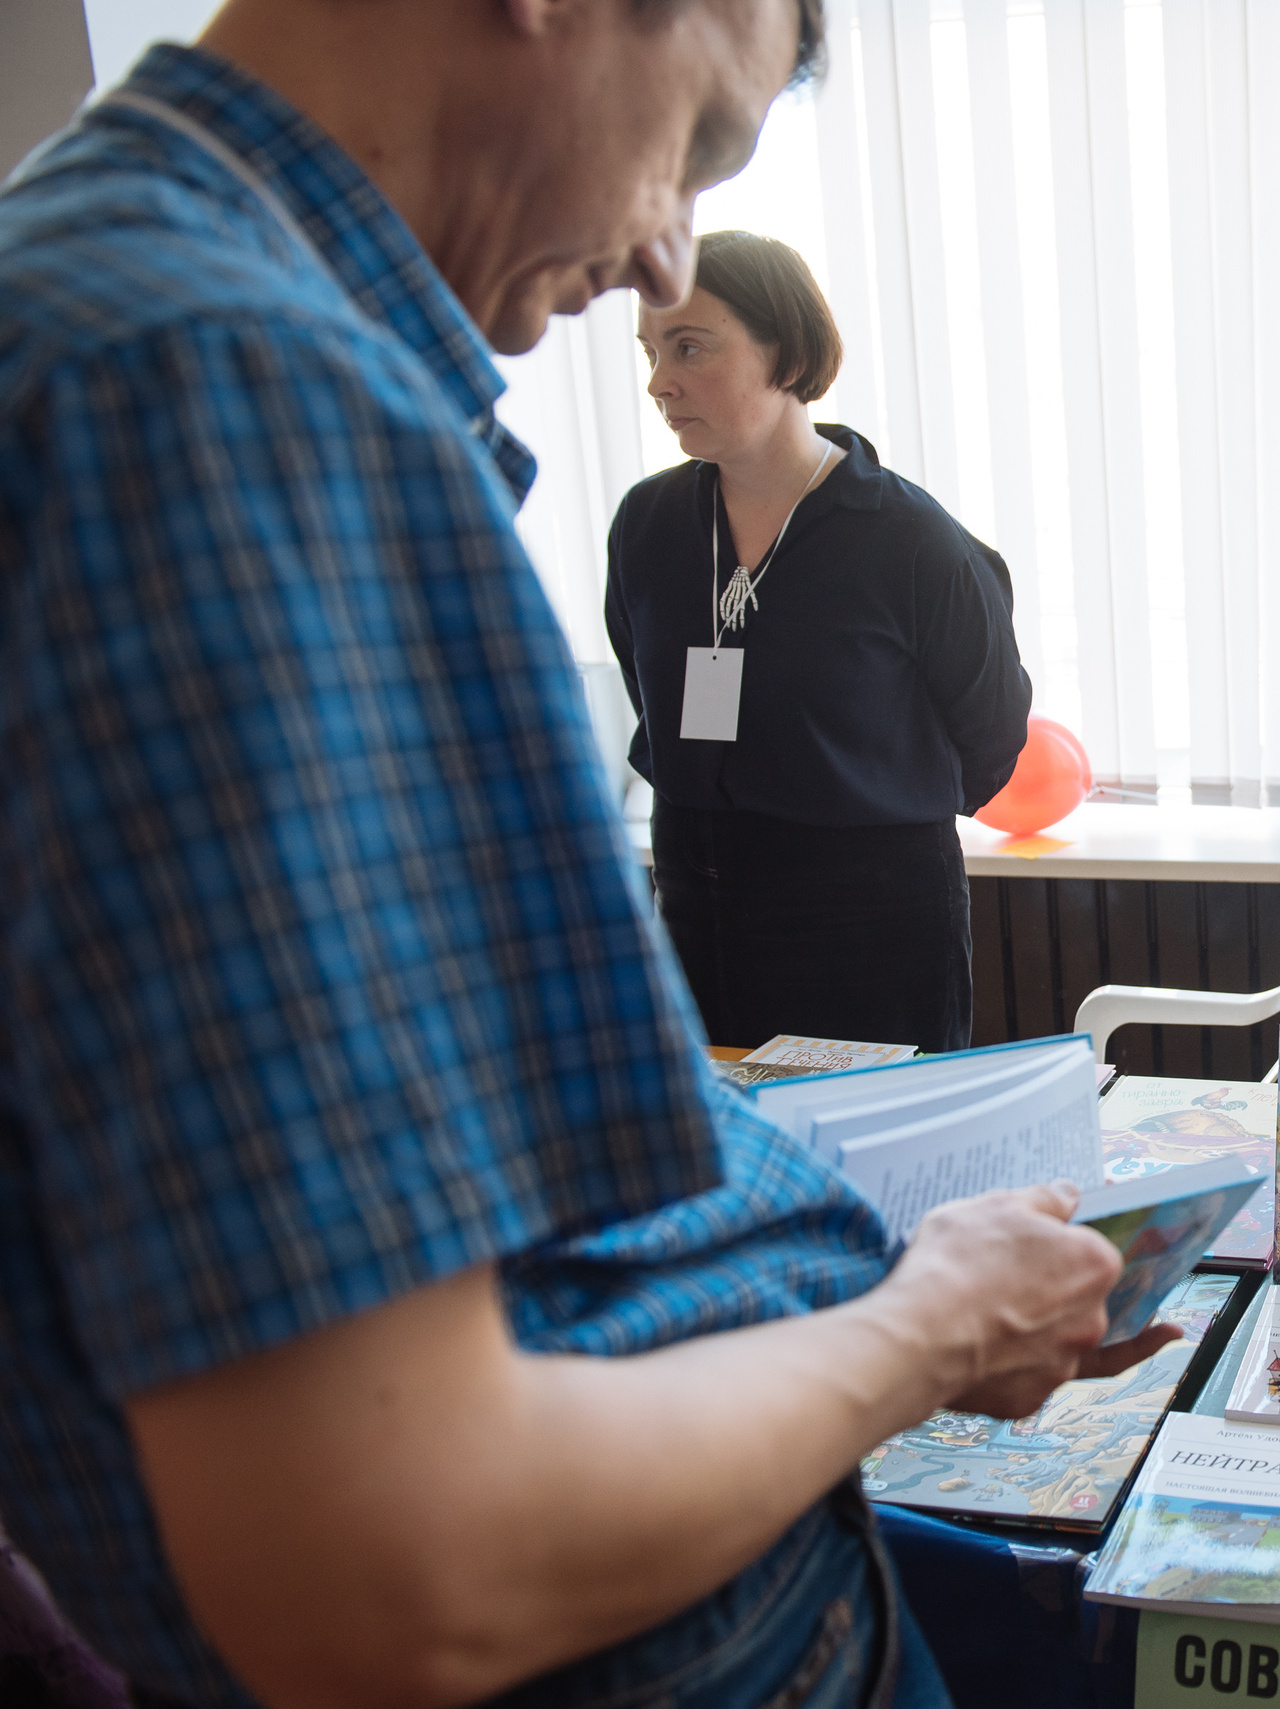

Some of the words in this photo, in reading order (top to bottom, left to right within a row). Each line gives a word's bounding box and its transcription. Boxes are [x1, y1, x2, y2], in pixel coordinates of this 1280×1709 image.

[783, 1050, 853, 1063] ПРОТИВ
[1122, 1090, 1186, 1099] тиранно-
[1139, 1099, 1183, 1107] завра
[1216, 1429, 1253, 1440] Артём
[1165, 1480, 1228, 1494] НАСТОЯЩАЯ
